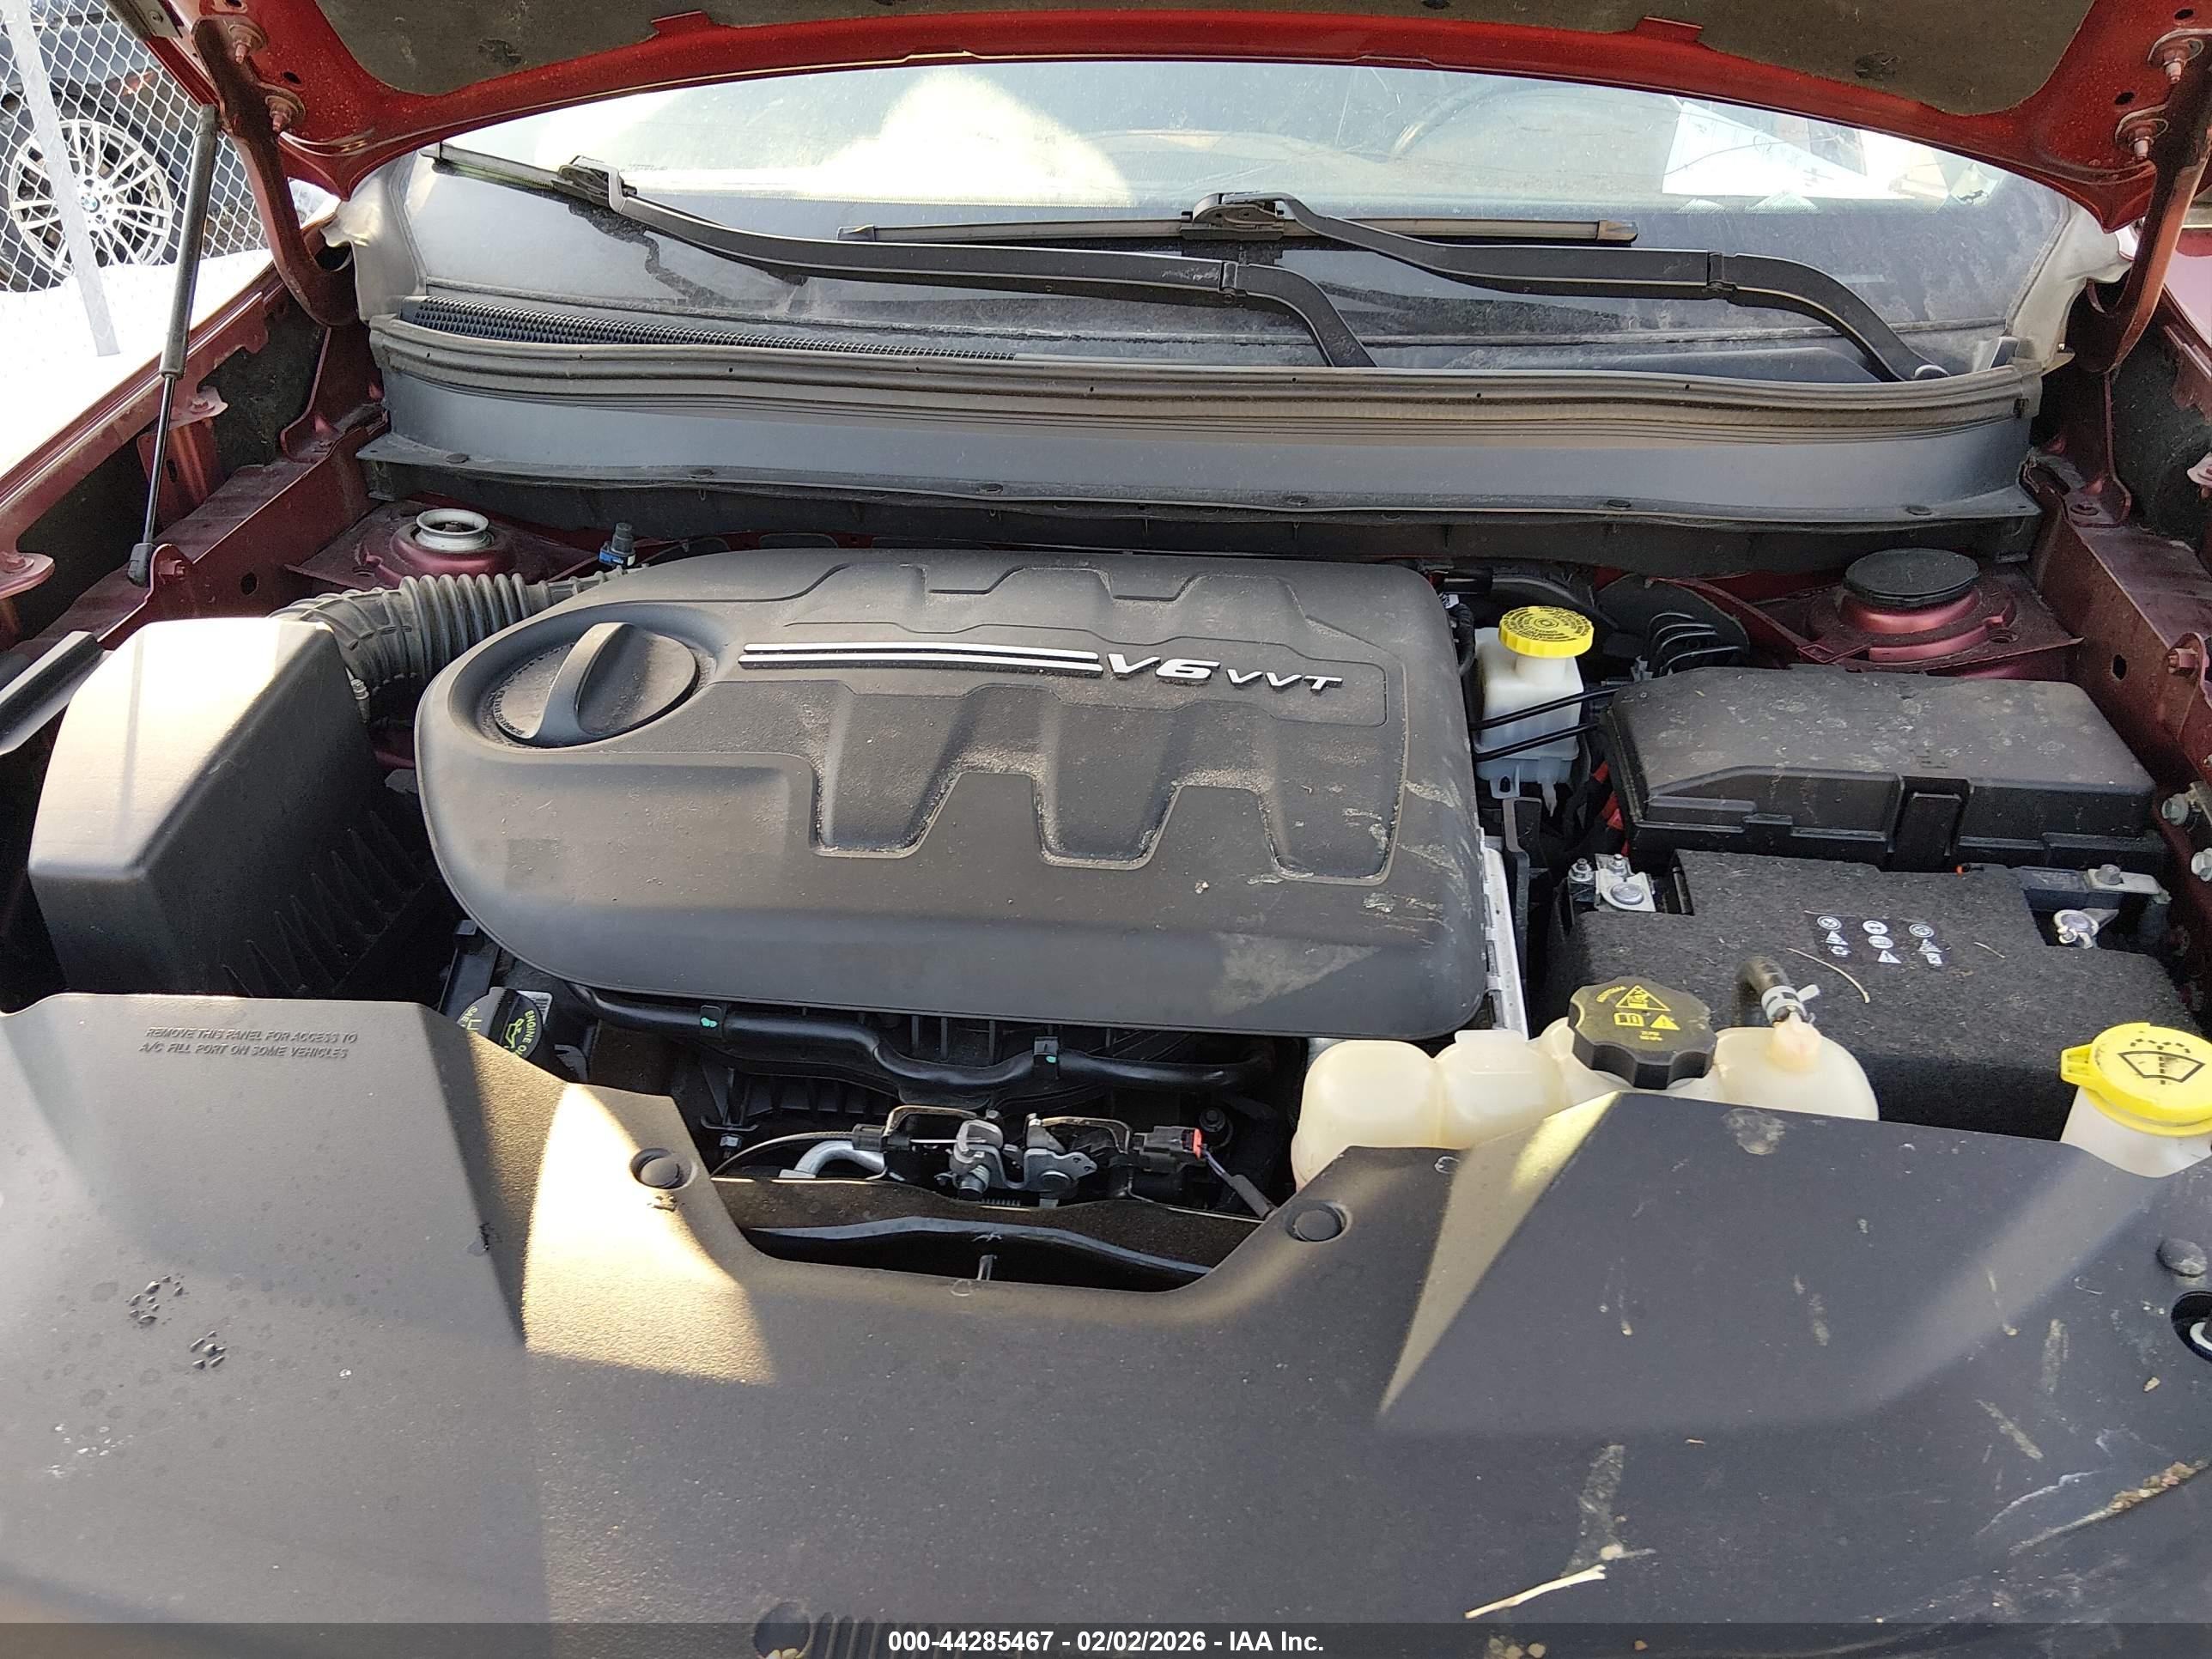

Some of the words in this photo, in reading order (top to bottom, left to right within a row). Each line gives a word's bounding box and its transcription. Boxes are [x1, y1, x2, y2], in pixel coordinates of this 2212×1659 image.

[1108, 653, 1220, 684] V6
[1226, 668, 1343, 691] VVT
[145, 1026, 198, 1038] REMOVE
[197, 1028, 225, 1039] THIS
[224, 1029, 262, 1041] PANEL
[264, 1030, 290, 1042] FOR
[290, 1030, 340, 1043] ACCESS
[342, 1031, 359, 1044] TO
[521, 1009, 537, 1044] ENGINE
[138, 1041, 165, 1053] A/C
[167, 1042, 191, 1054] FILL
[194, 1043, 229, 1054] PORT
[230, 1044, 252, 1055] ON
[251, 1045, 288, 1057] SOME
[290, 1046, 349, 1059] VEHICLES
[515, 1044, 527, 1055] OI
